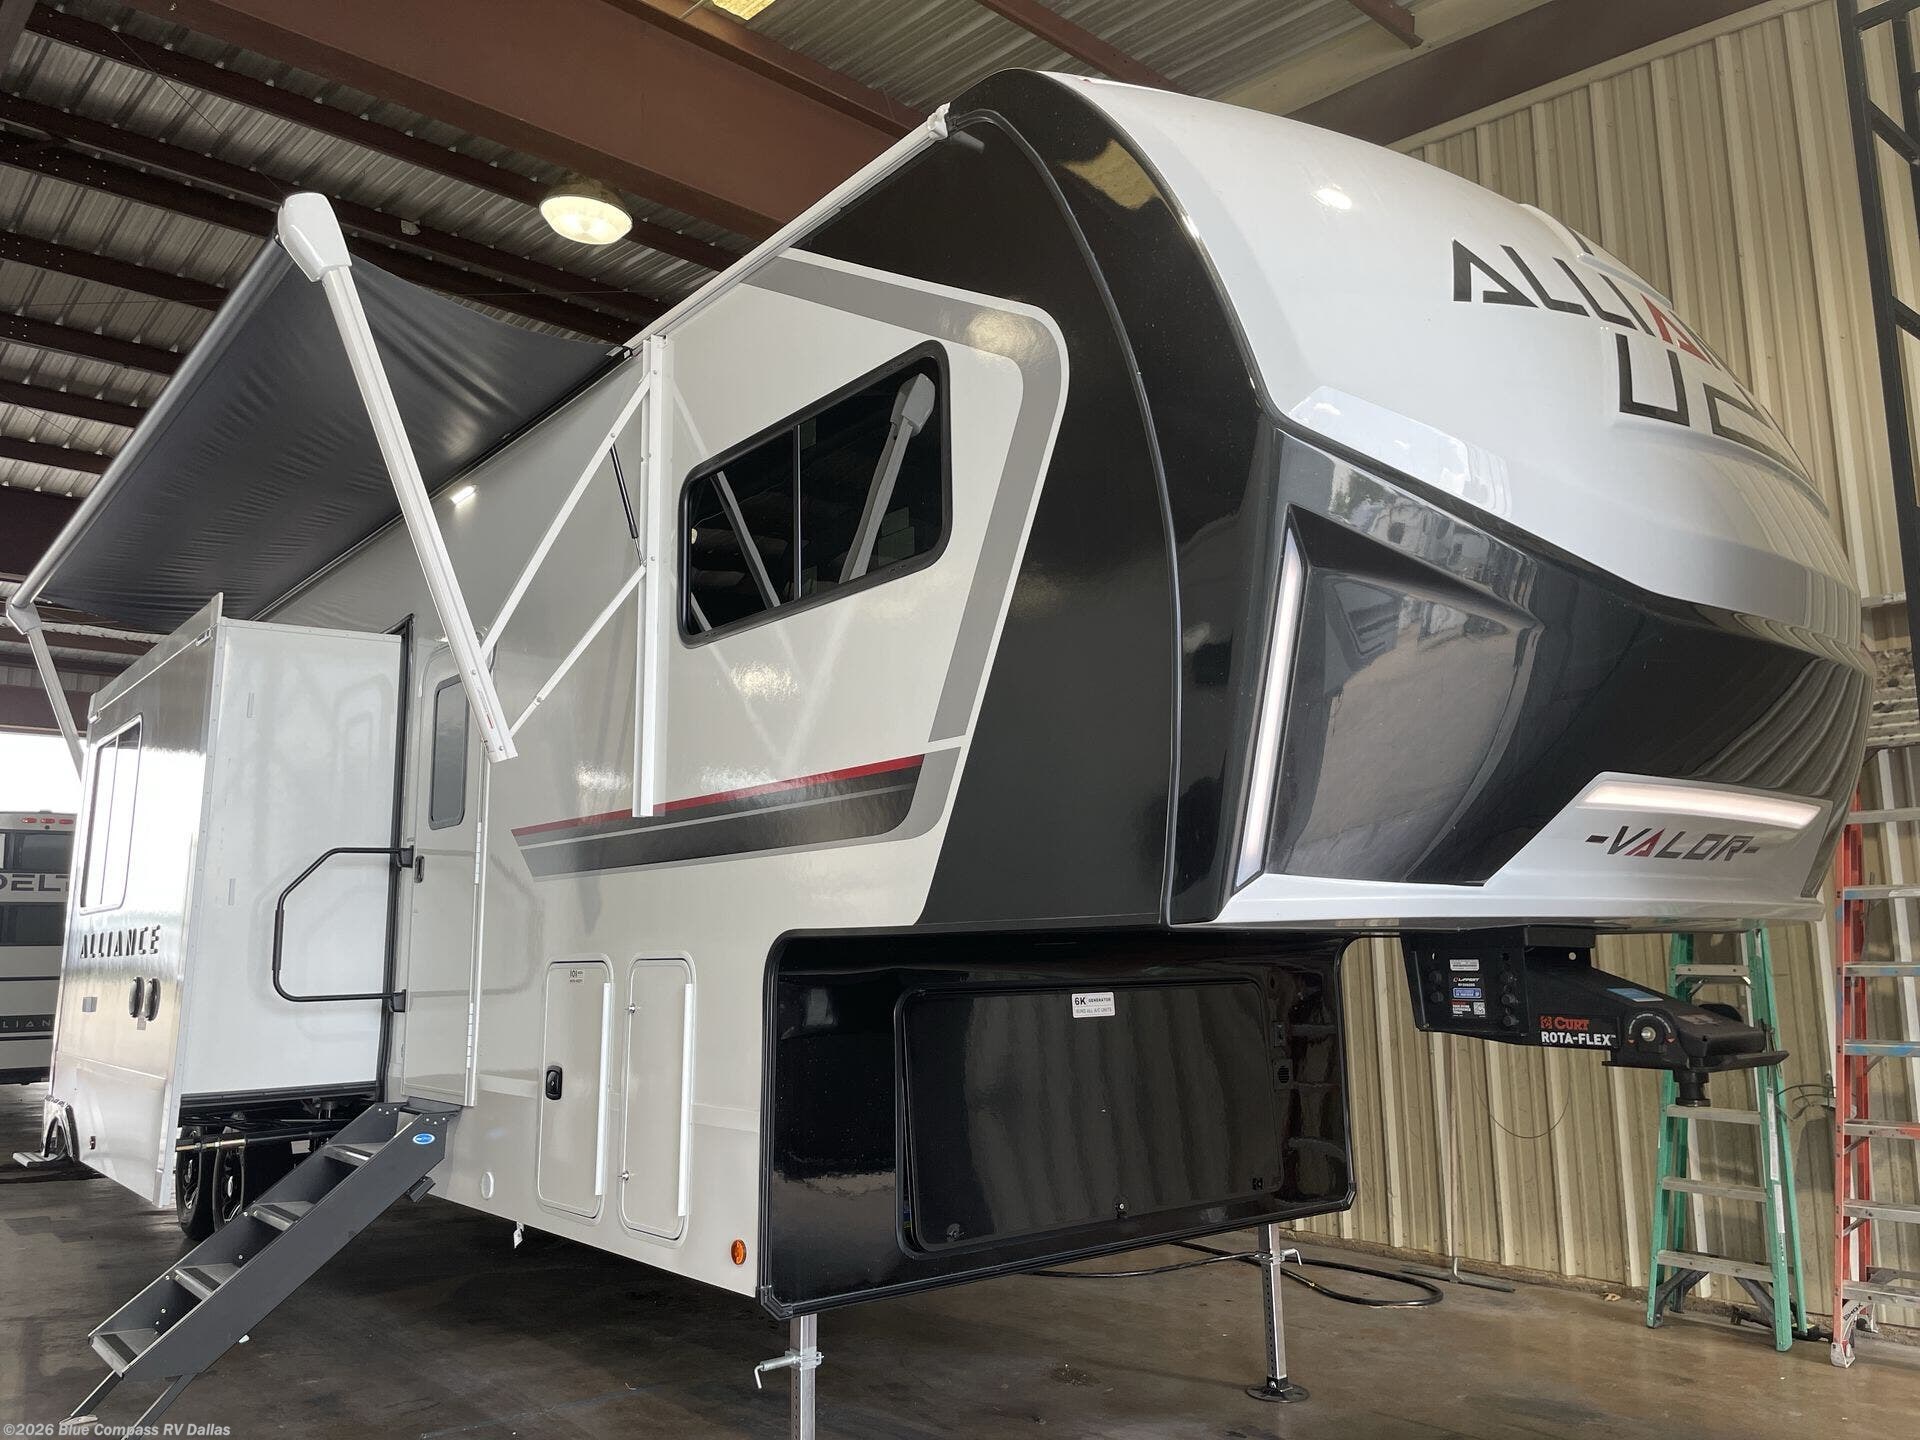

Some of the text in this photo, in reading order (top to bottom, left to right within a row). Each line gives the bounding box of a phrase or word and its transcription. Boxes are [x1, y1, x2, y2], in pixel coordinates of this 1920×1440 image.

[80, 924, 161, 959] ALLIANCE
[1074, 997, 1086, 1005] 6K
[1554, 1016, 1590, 1031] CURT
